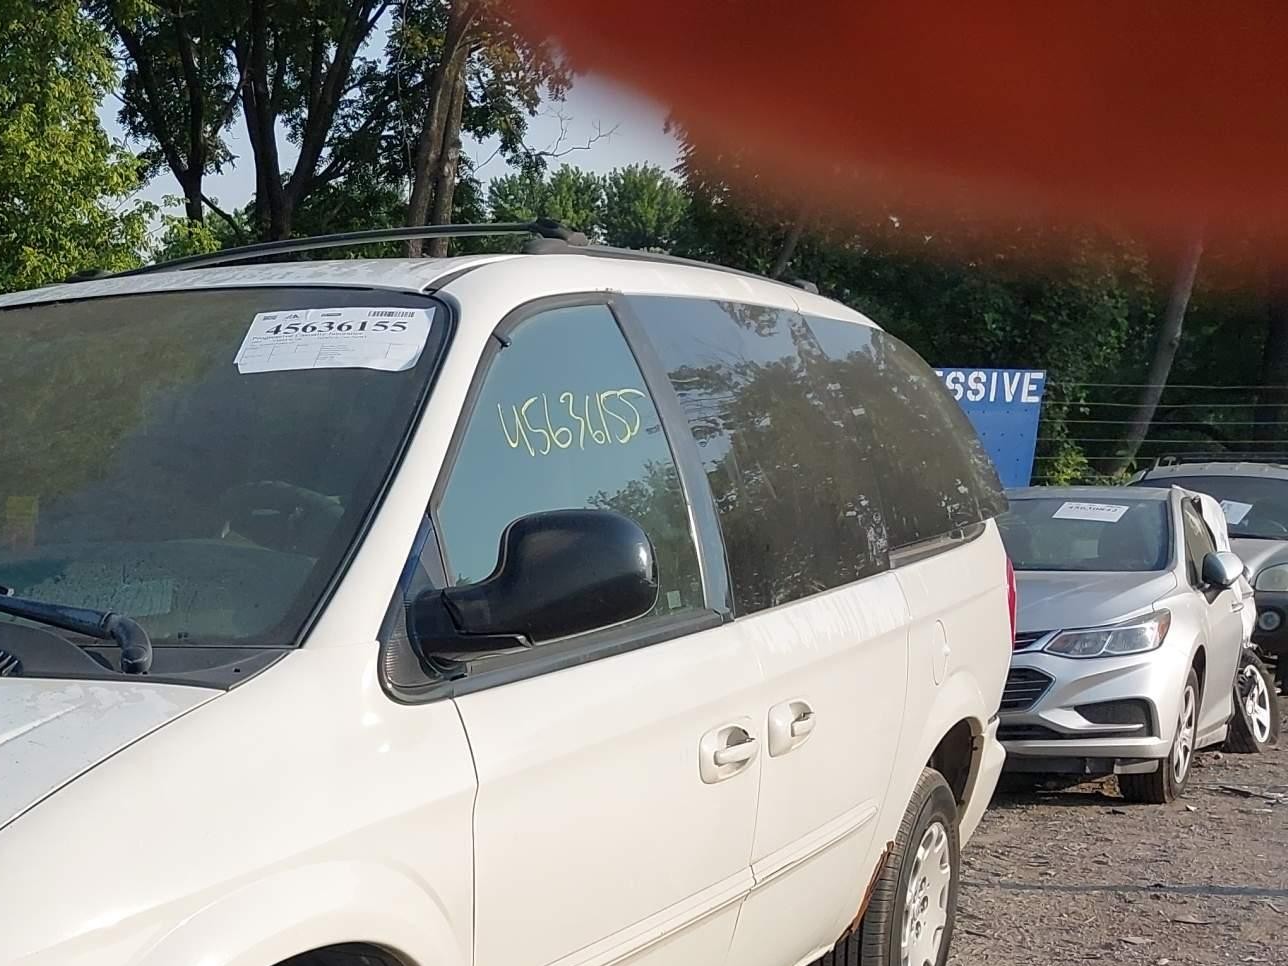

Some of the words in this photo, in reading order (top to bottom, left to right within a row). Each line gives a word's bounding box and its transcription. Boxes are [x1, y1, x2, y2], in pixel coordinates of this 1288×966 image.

[265, 321, 409, 335] 45636155
[935, 370, 1044, 403] SSIVE
[498, 388, 646, 456] 45636155
